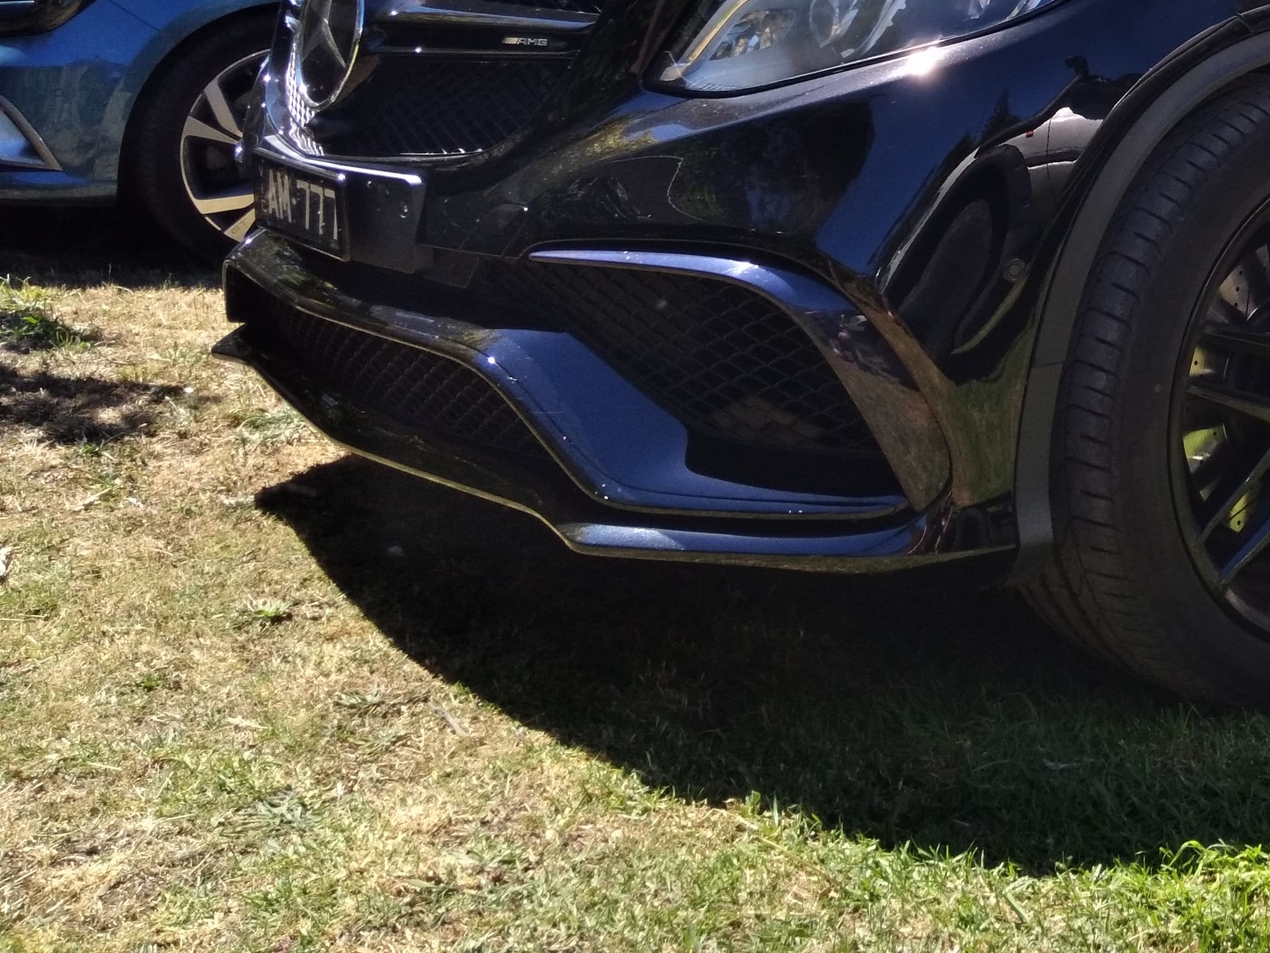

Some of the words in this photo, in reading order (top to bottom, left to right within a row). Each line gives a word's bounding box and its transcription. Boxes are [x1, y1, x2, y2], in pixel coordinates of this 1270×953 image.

[518, 37, 548, 47] AMG
[268, 168, 292, 223] AM
[296, 179, 338, 241] 777
